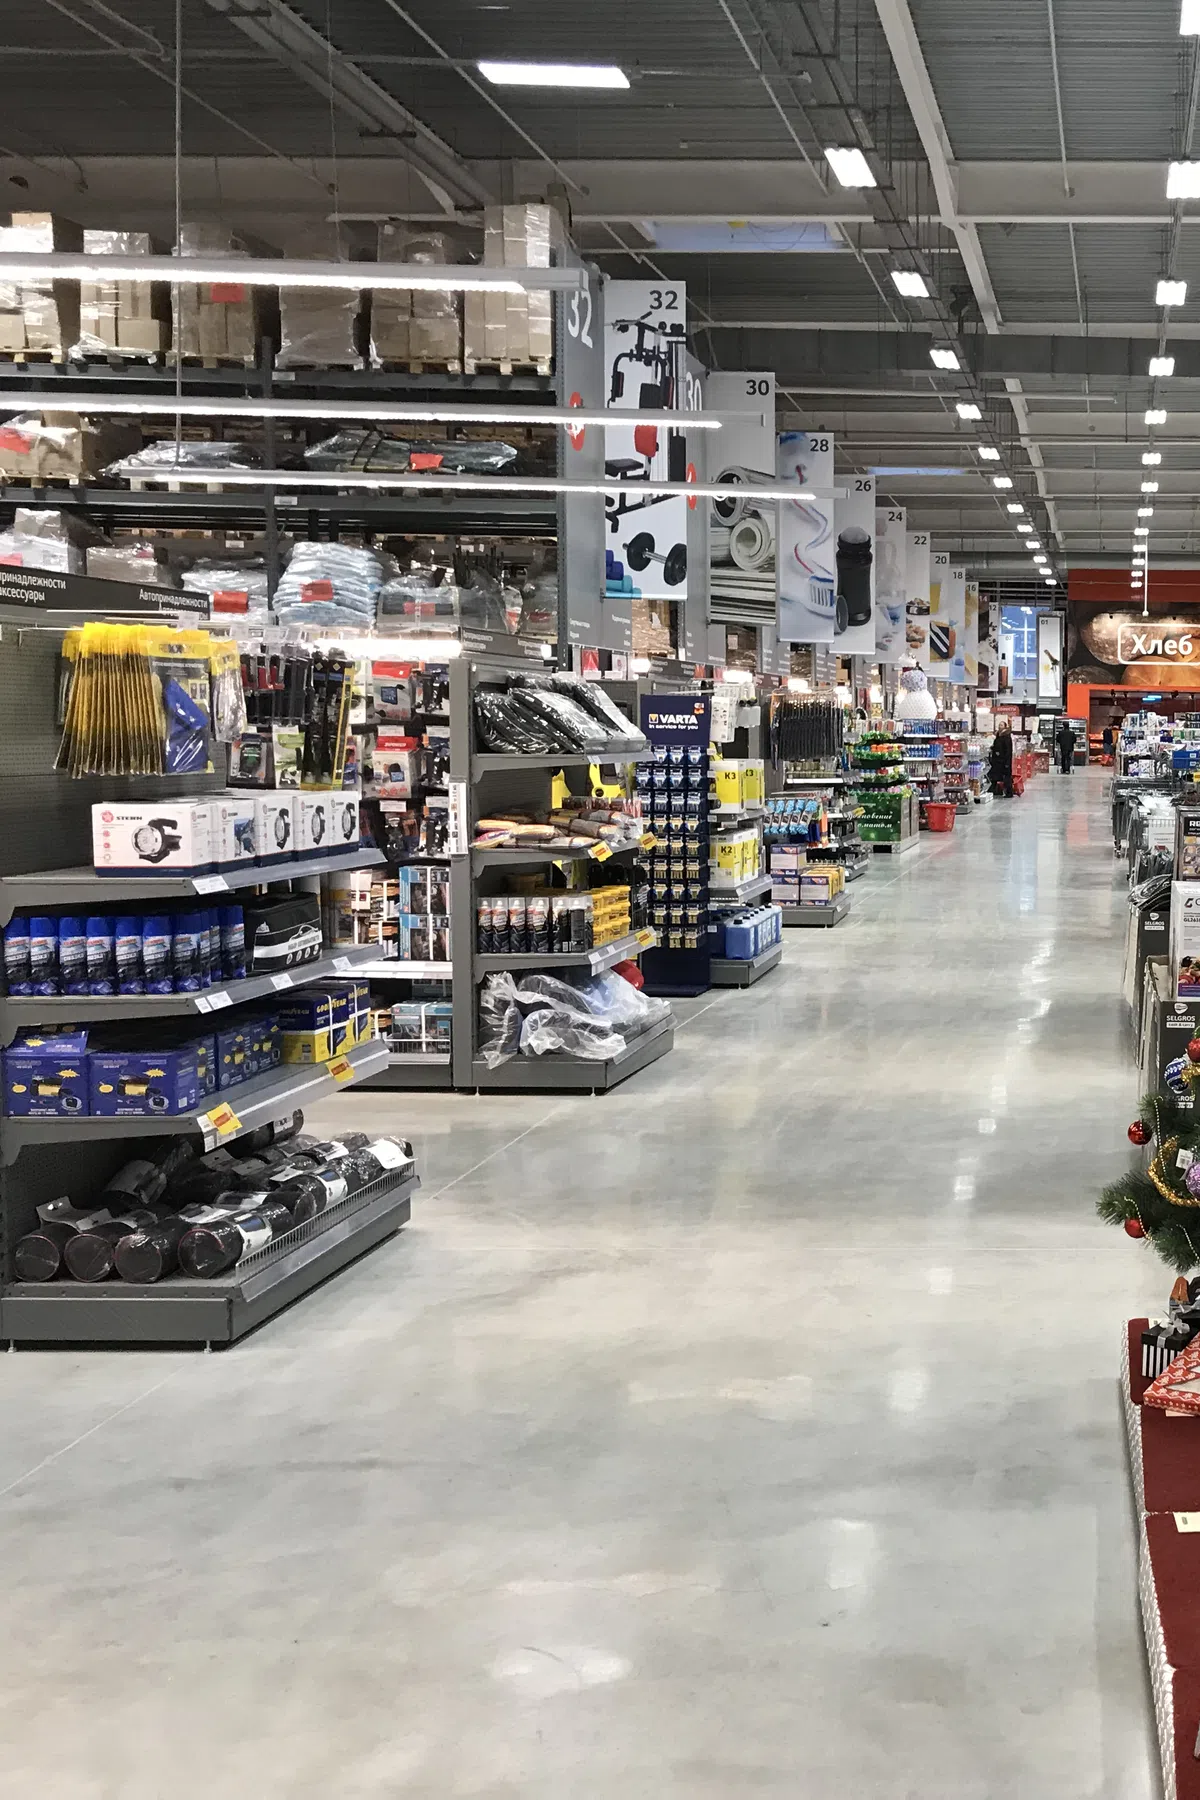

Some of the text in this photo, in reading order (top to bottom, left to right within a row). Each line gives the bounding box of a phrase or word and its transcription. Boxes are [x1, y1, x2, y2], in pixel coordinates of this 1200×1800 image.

[649, 290, 679, 311] 32
[567, 289, 593, 348] 32
[745, 379, 770, 396] 30
[809, 438, 830, 453] 28
[854, 479, 872, 492] 26
[888, 511, 903, 522] 24
[913, 535, 927, 546] 22
[934, 555, 947, 565] 20
[953, 571, 963, 580] 18
[966, 584, 977, 592] 16
[139, 588, 208, 609] Автопринадлежности
[1131, 633, 1193, 656] Хлеб
[659, 714, 699, 724] VARTA
[724, 771, 736, 780] K3
[720, 846, 733, 854] K2
